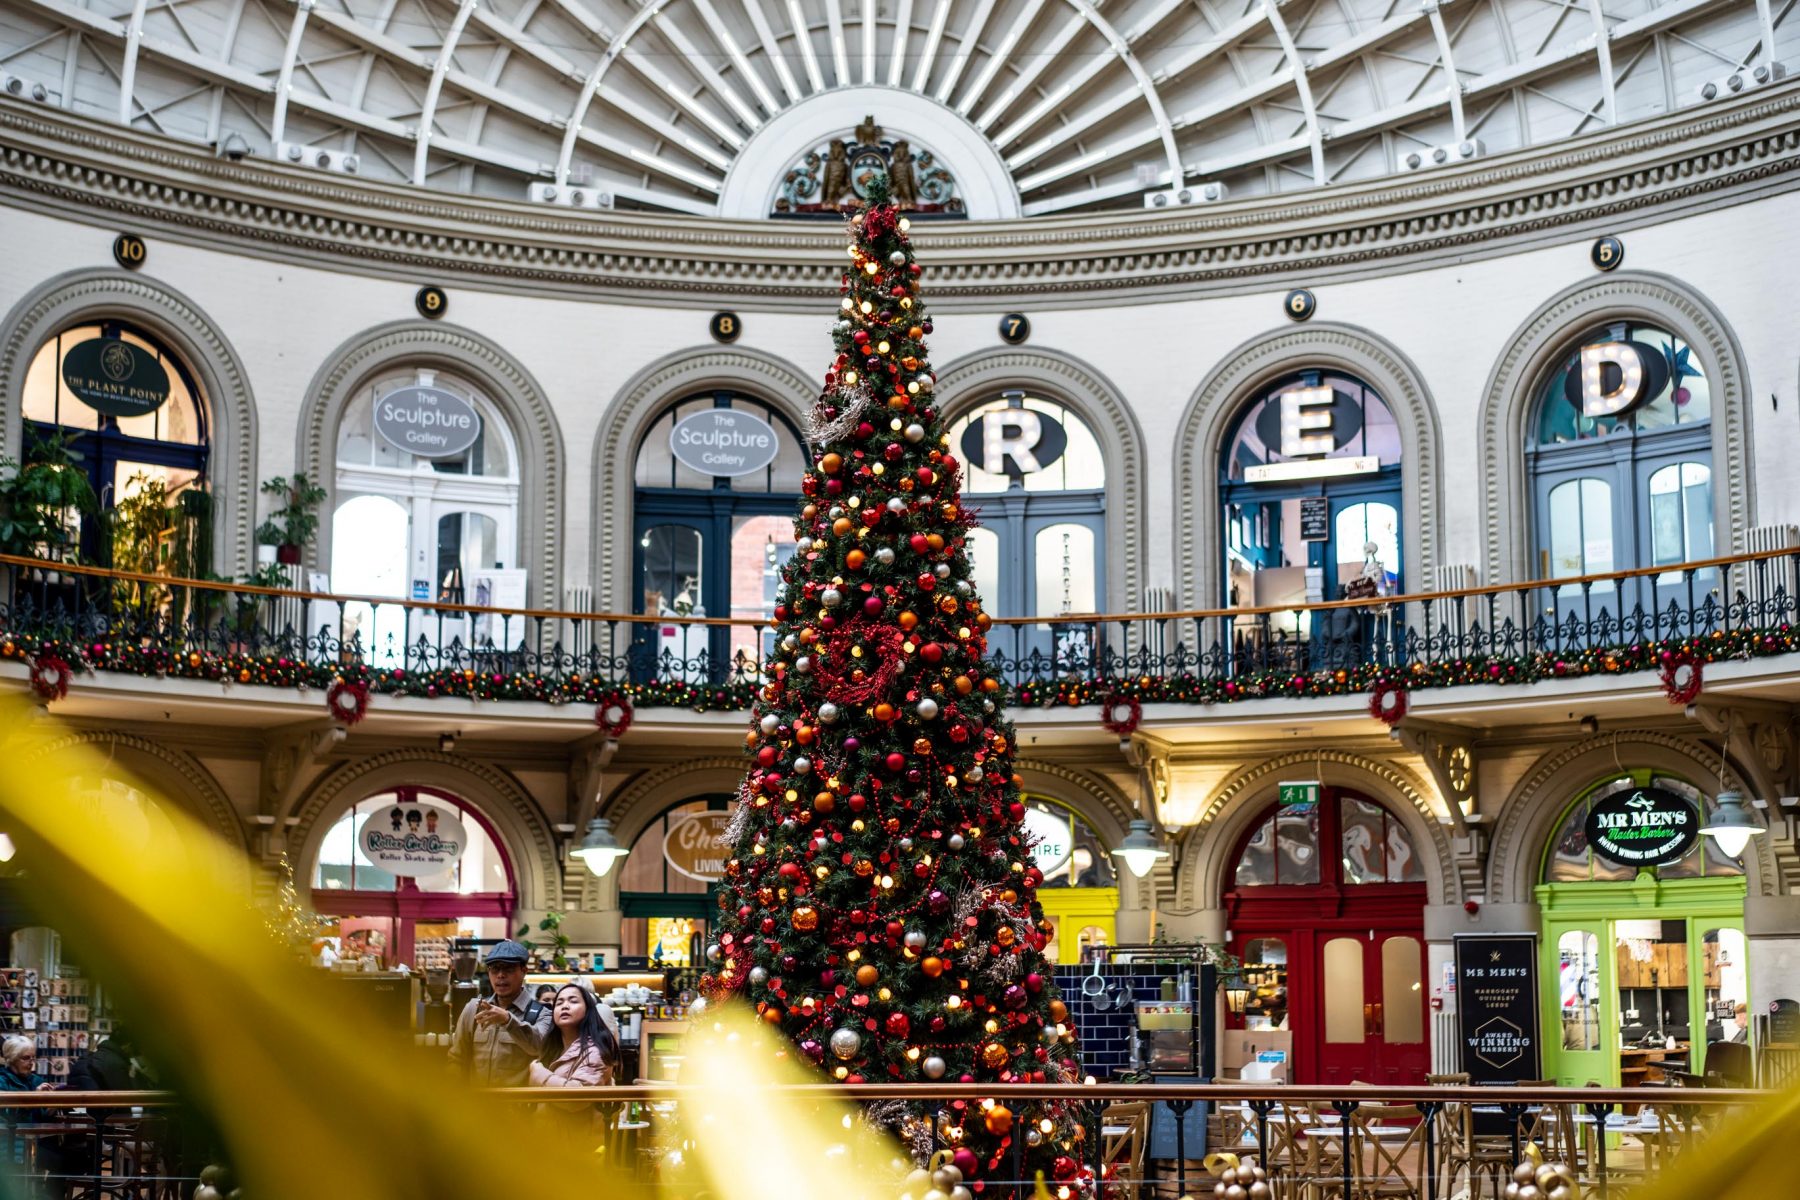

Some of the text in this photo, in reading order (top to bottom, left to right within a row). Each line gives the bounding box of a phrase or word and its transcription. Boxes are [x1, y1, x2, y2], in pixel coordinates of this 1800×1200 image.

[122, 239, 143, 260] 10
[1600, 243, 1612, 261] 5
[426, 292, 440, 309] 9
[1291, 294, 1305, 312] 6
[719, 317, 733, 334] 8
[1008, 319, 1020, 336] 7
[1581, 341, 1643, 417] D
[68, 376, 83, 386] THE
[88, 380, 125, 395] PLANT
[129, 387, 163, 401] POINT
[417, 392, 438, 405] The
[384, 403, 470, 428] Sculpture
[714, 415, 735, 426] The
[1281, 385, 1335, 457] E
[406, 430, 447, 447] Gallery
[680, 428, 769, 449] Sculpture
[983, 409, 1042, 473] R
[702, 453, 745, 466] Gallery
[1063, 533, 1071, 616] PIERCIN
[1597, 810, 1687, 828] MR MEN'S
[679, 819, 732, 850] Che
[1607, 826, 1676, 840] Master Barbers
[368, 832, 458, 855] Roller Girl Gang
[1597, 831, 1686, 860] AWARD WINNING HAIR DRESSING
[380, 853, 401, 861] Roller
[404, 854, 425, 862] Skate
[1466, 967, 1527, 977] MR MEN'S
[1468, 1038, 1530, 1047] WINNING
